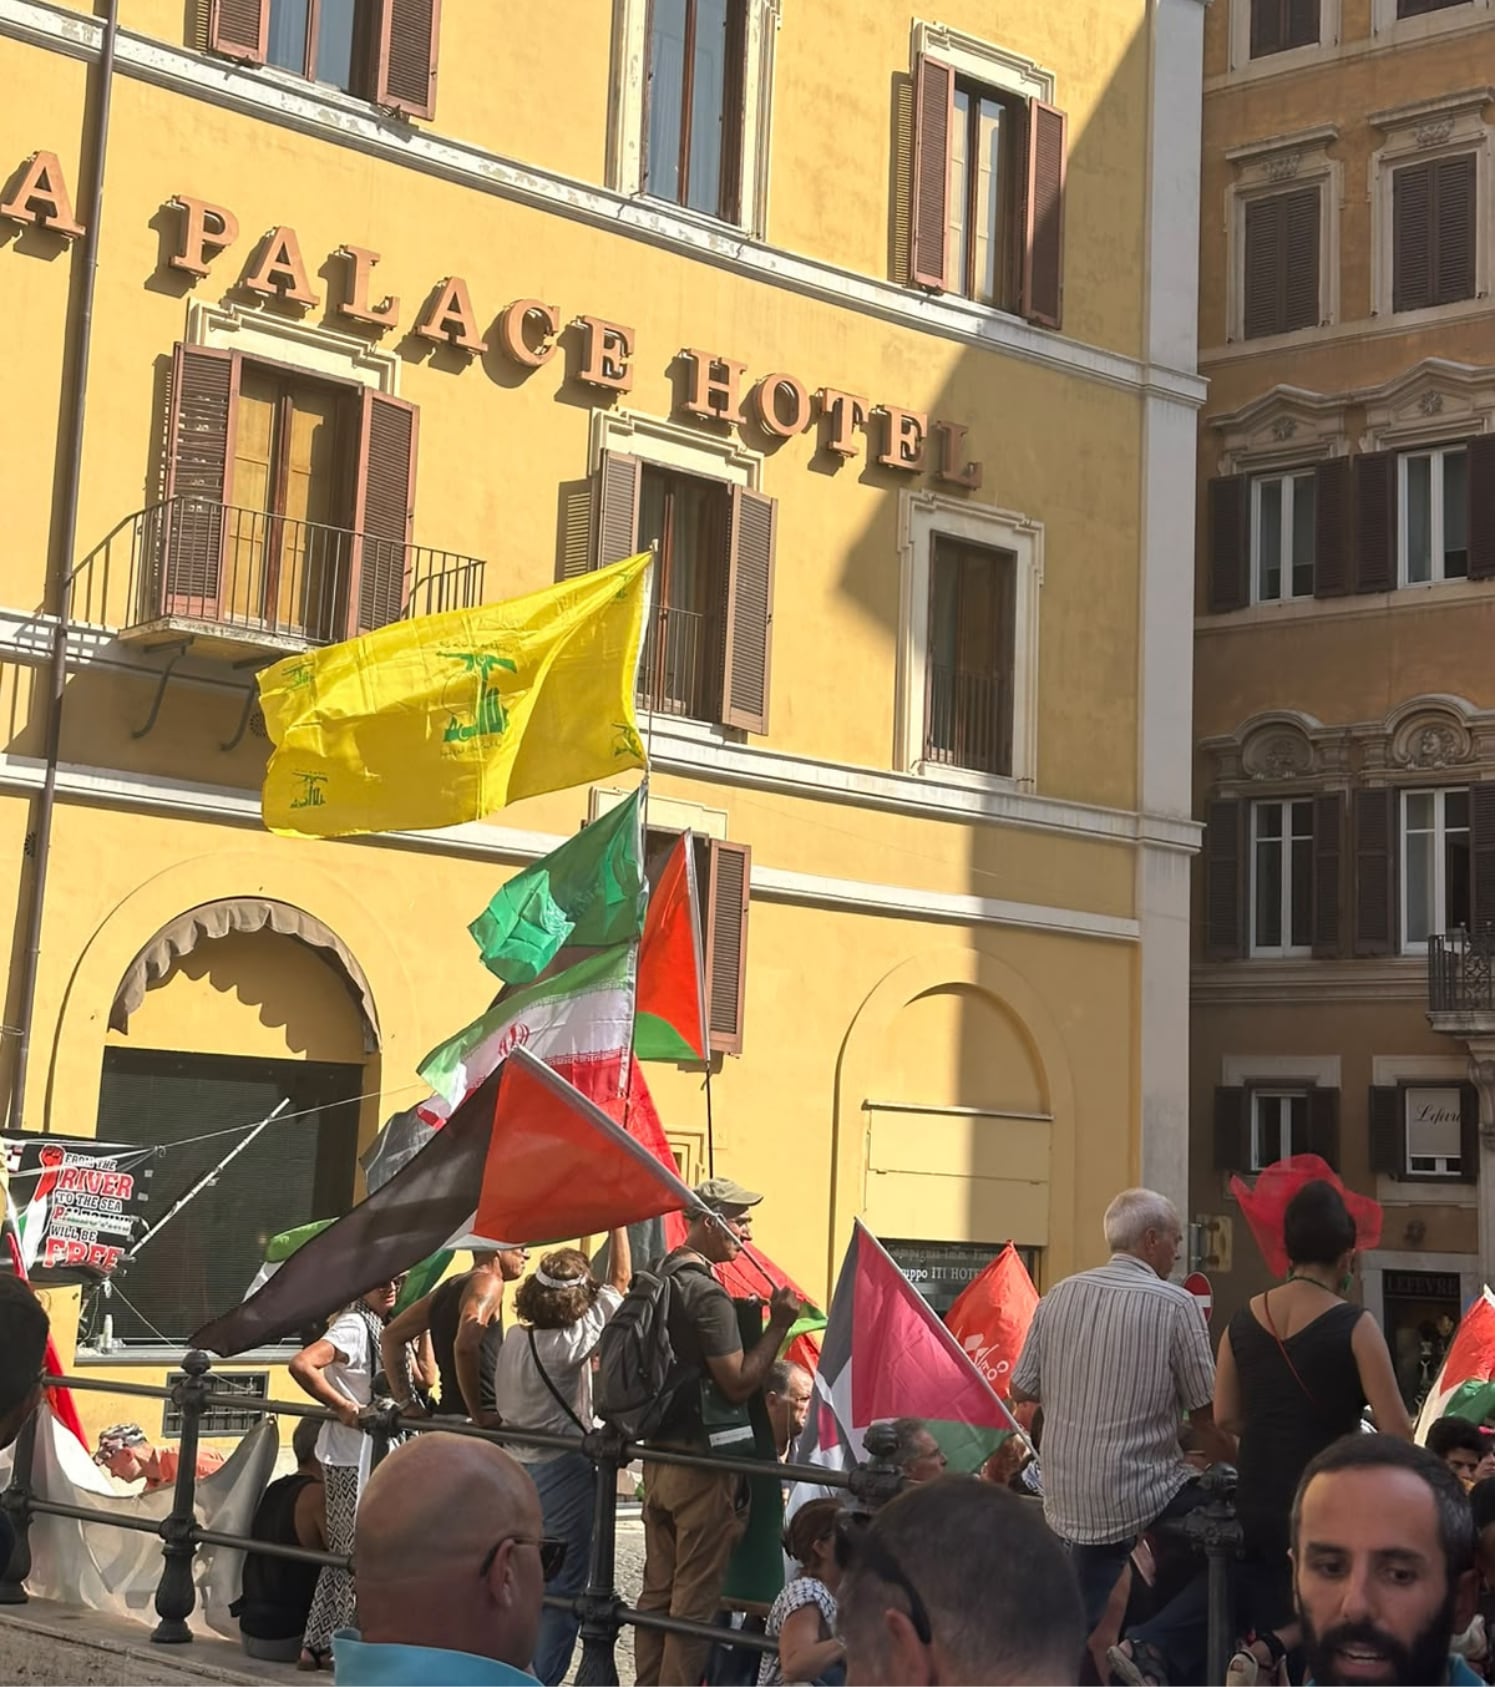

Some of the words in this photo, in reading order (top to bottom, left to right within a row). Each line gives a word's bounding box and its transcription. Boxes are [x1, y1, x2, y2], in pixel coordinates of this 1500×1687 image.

[168, 193, 635, 394] PALACE
[681, 347, 984, 490] HOTEL
[59, 1167, 133, 1198] RIVER
[57, 1191, 75, 1204] TO
[77, 1194, 99, 1208] THE
[100, 1198, 122, 1212] SEA
[50, 1225, 78, 1239] WILL
[81, 1230, 97, 1242] BE
[900, 1266, 928, 1282] uppo
